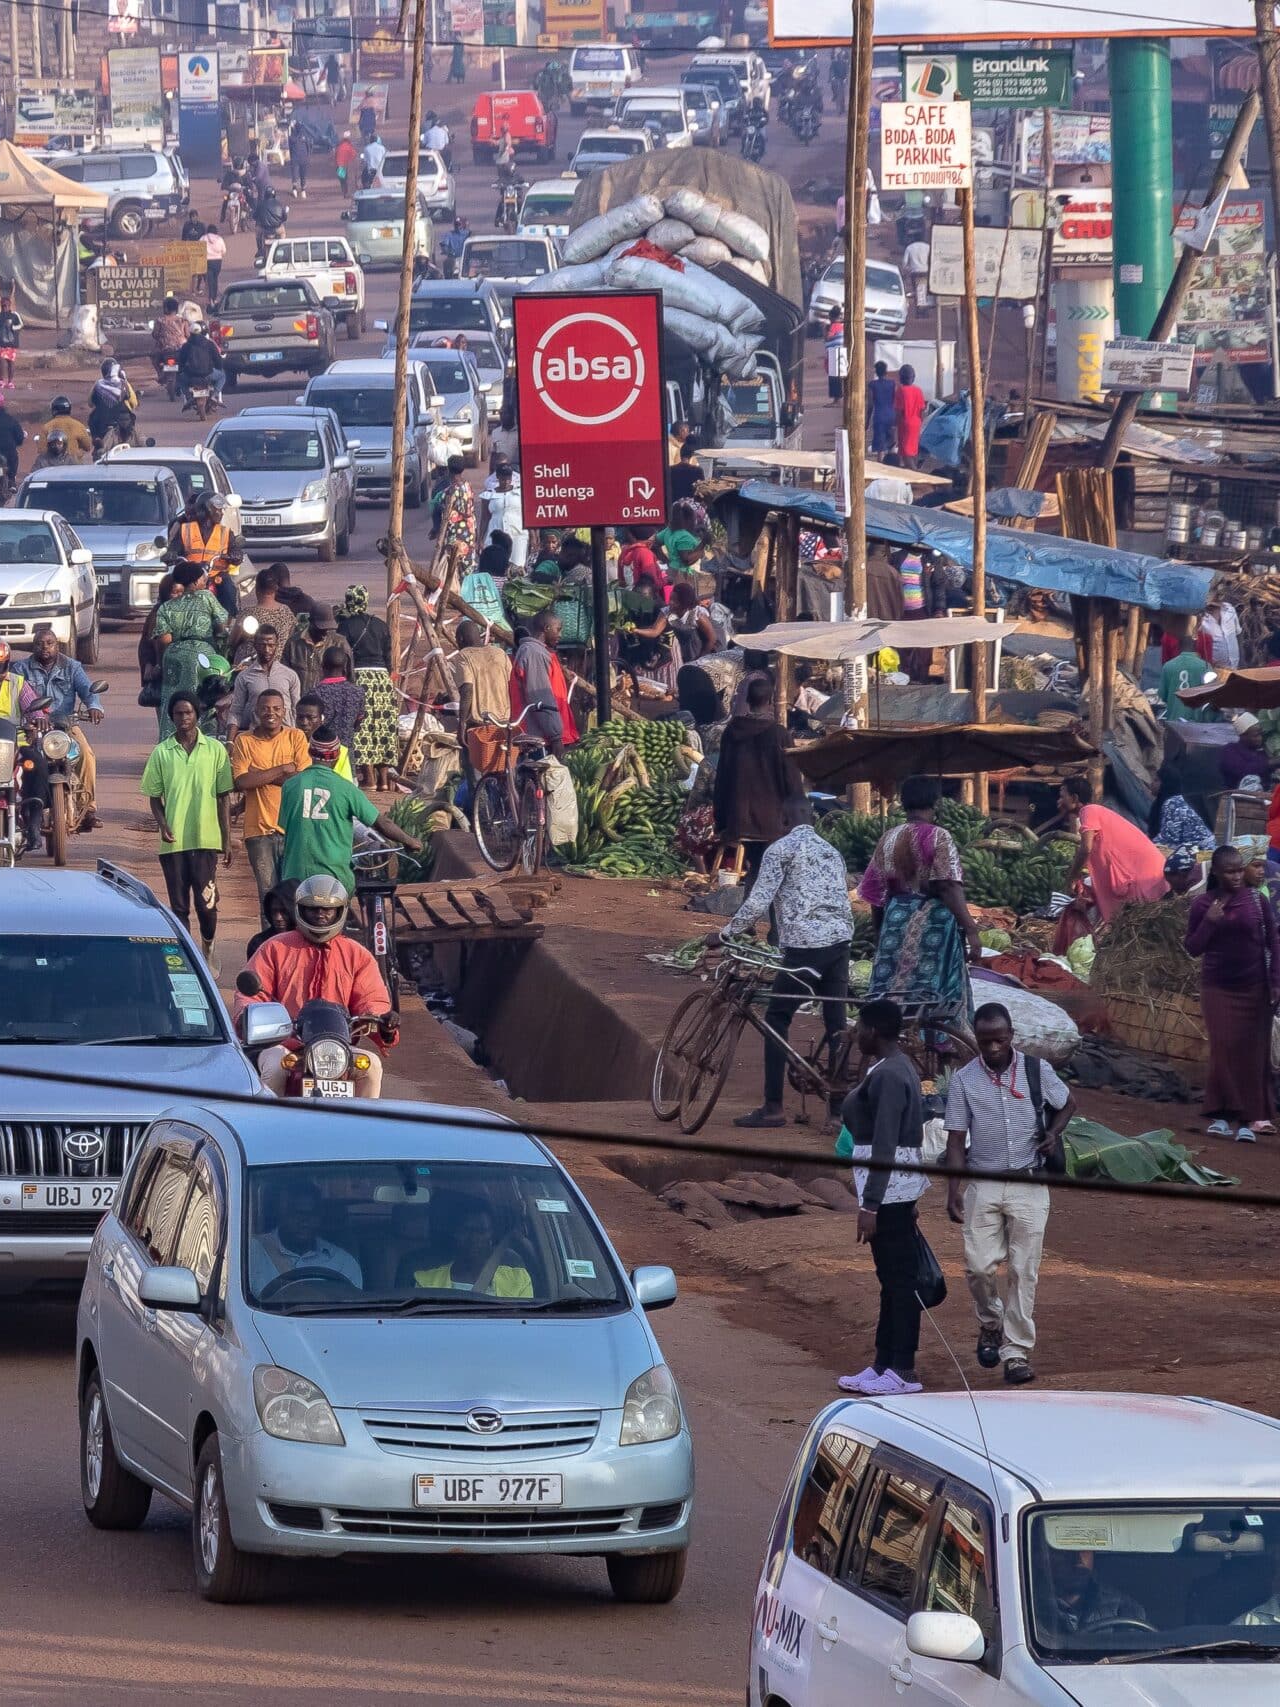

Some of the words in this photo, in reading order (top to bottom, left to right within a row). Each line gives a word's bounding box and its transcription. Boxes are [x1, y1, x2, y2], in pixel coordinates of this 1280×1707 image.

[905, 106, 947, 126] SAFE
[885, 129, 916, 144] BODA
[925, 128, 956, 144] BODA
[896, 148, 952, 165] PARKING
[99, 267, 139, 278] MUZEI
[142, 267, 161, 278] JET
[101, 280, 123, 289] CAR
[126, 279, 158, 289] WASH
[108, 290, 152, 298] T.CUT
[99, 300, 150, 308] POLISH
[547, 346, 631, 381] absa
[534, 464, 569, 478] Shell
[535, 484, 594, 500] Bulenga
[536, 505, 568, 518] ATM
[303, 787, 331, 819] 12
[128, 937, 179, 945] COSMOS
[322, 1081, 347, 1092] UGJ
[46, 1187, 80, 1206] UBJ
[92, 1187, 114, 1206] 92
[444, 1479, 484, 1501] UBF
[499, 1478, 551, 1501] 977F
